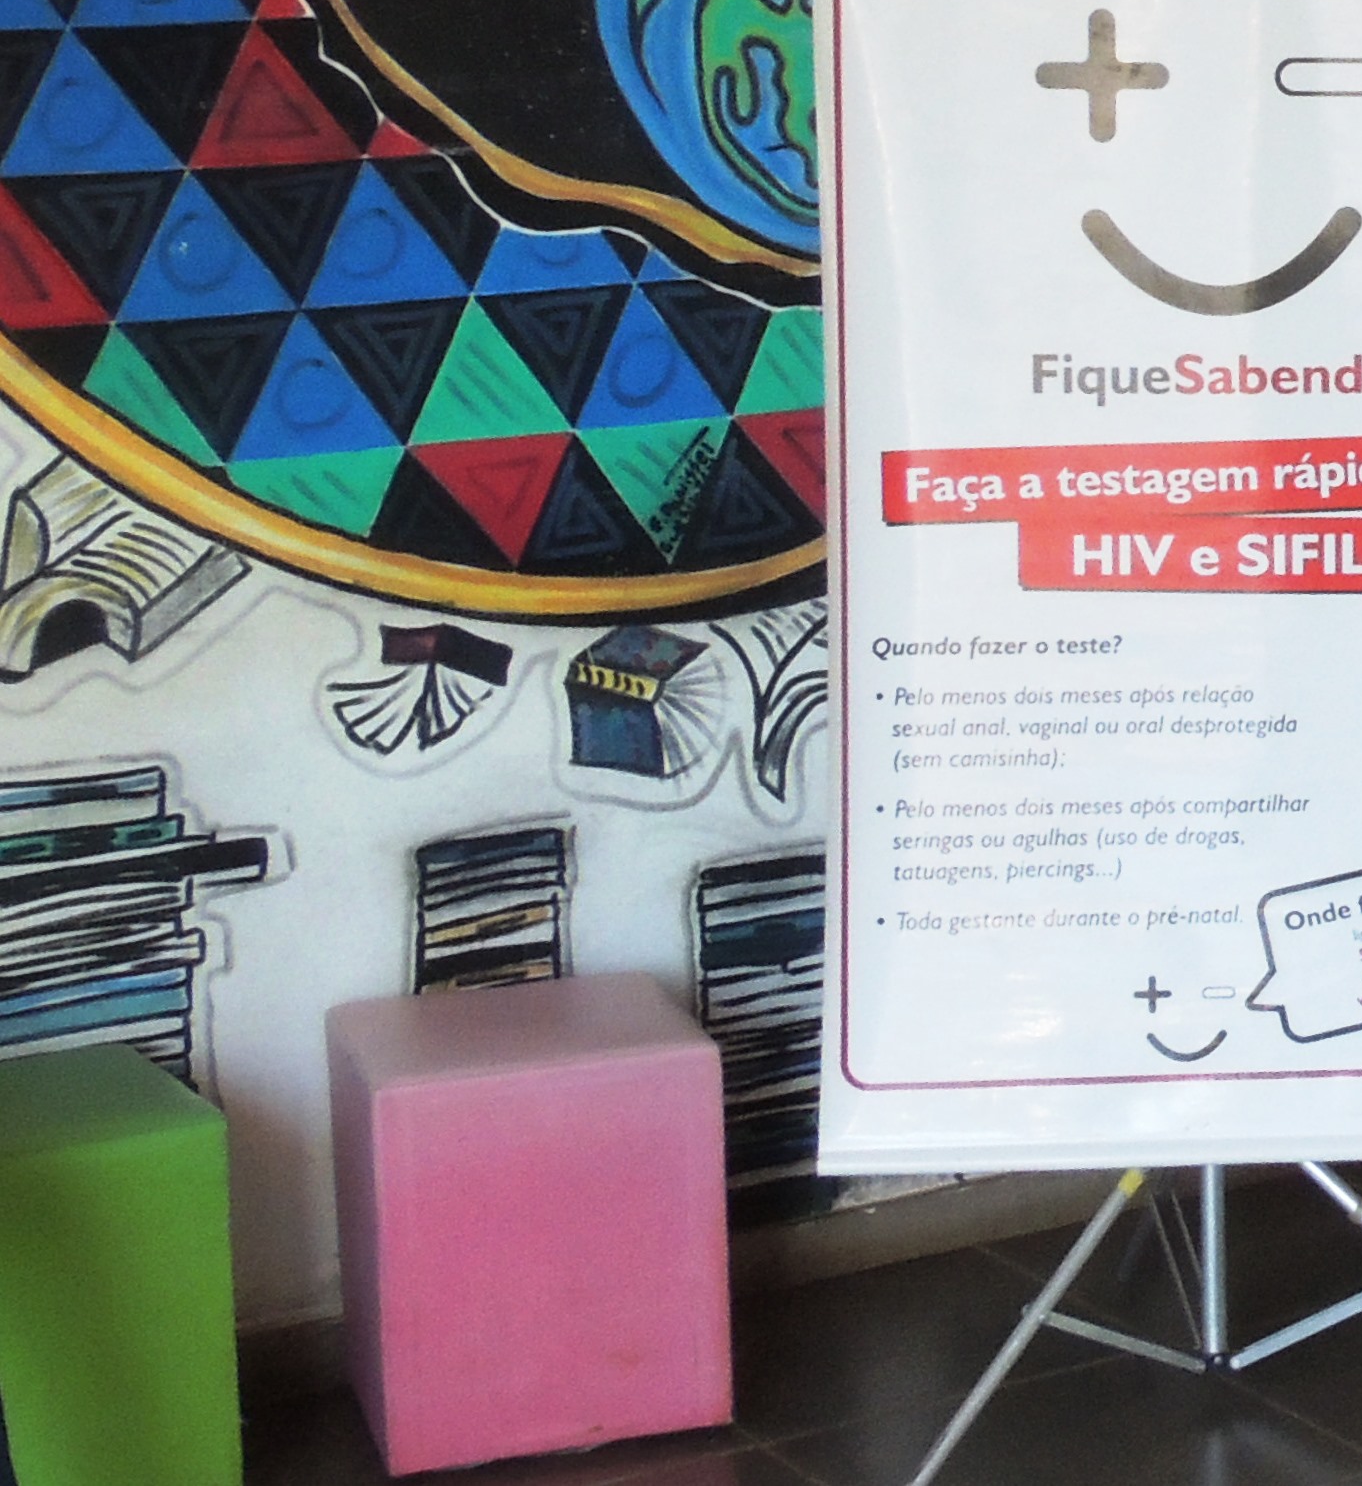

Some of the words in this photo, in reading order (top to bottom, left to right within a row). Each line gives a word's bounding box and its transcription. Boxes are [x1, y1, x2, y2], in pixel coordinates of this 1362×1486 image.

[905, 466, 1004, 511] Faça
[1018, 474, 1043, 499] a
[1057, 459, 1259, 504] testagem
[1072, 534, 1175, 576] HIV
[1190, 545, 1220, 576] e
[871, 636, 962, 659] Quando
[969, 636, 1029, 660] fazer
[1035, 640, 1049, 655] o
[1056, 635, 1123, 656] teste?
[894, 686, 935, 707] Pelo
[941, 690, 1008, 706] menos
[1014, 686, 1054, 705] dois
[1060, 689, 1123, 705] meses
[1129, 685, 1175, 707] após
[1182, 684, 1255, 709] relação
[891, 717, 956, 738] sexual
[1019, 716, 1089, 741] vaginal
[1095, 720, 1119, 736] ou
[1126, 716, 1165, 736] oral
[1170, 714, 1298, 740] desprotegida
[893, 748, 943, 774] (sem
[894, 798, 935, 819] Pelo
[942, 802, 1008, 818] menos
[1014, 797, 1055, 817] dois
[1061, 800, 1123, 816] meses
[1129, 795, 1176, 819] após
[1183, 794, 1310, 817] compartilhar
[892, 830, 974, 854] seringas
[980, 832, 1006, 848] ou
[1012, 827, 1089, 853] agulhas
[1096, 827, 1139, 850] (uso
[1144, 827, 1169, 846] de
[896, 911, 943, 932] Toda
[948, 910, 1037, 935] gestante
[1043, 908, 1121, 928] durante
[1128, 911, 1139, 926] o
[1146, 904, 1244, 930] pré-natal.
[1284, 902, 1352, 931] Onde
